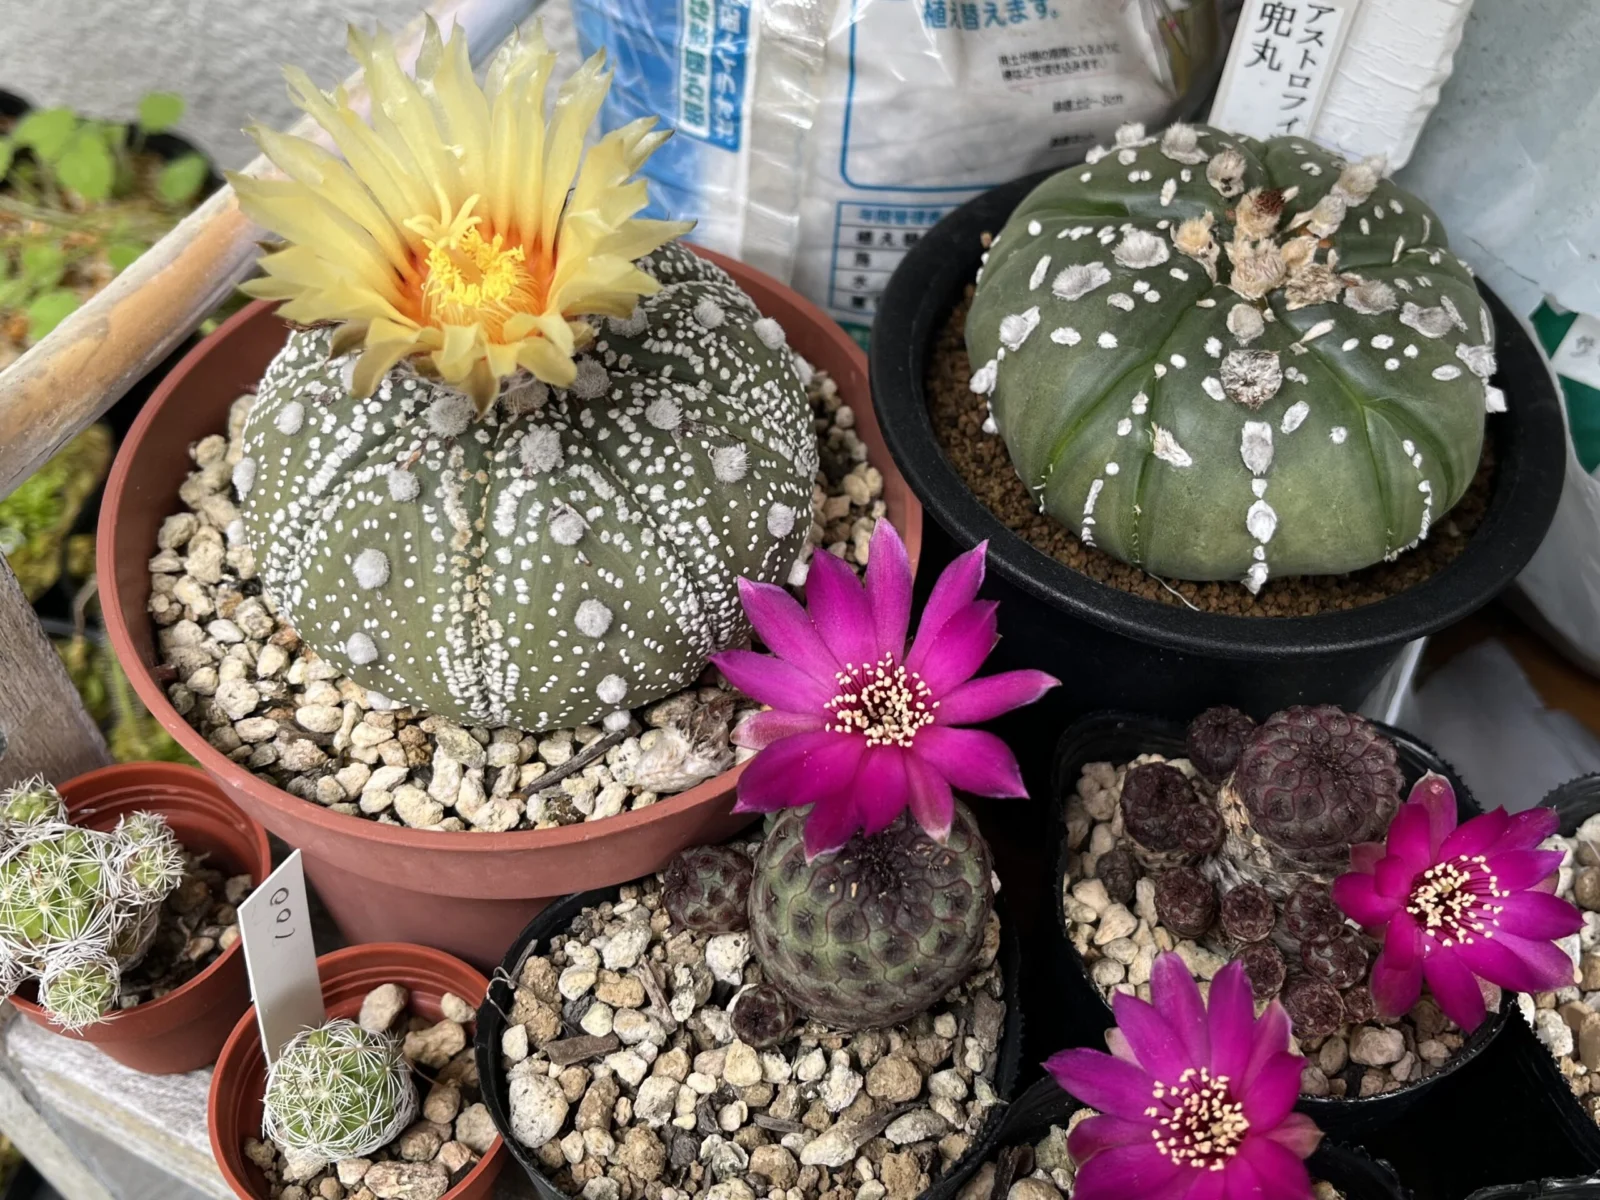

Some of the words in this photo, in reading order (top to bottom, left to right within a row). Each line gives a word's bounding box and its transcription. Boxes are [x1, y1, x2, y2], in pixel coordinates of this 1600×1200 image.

[713, 0, 742, 138] ゼオライト配
[1244, 1, 1296, 72] 兜丸
[1272, 3, 1335, 137] アストロフィ
